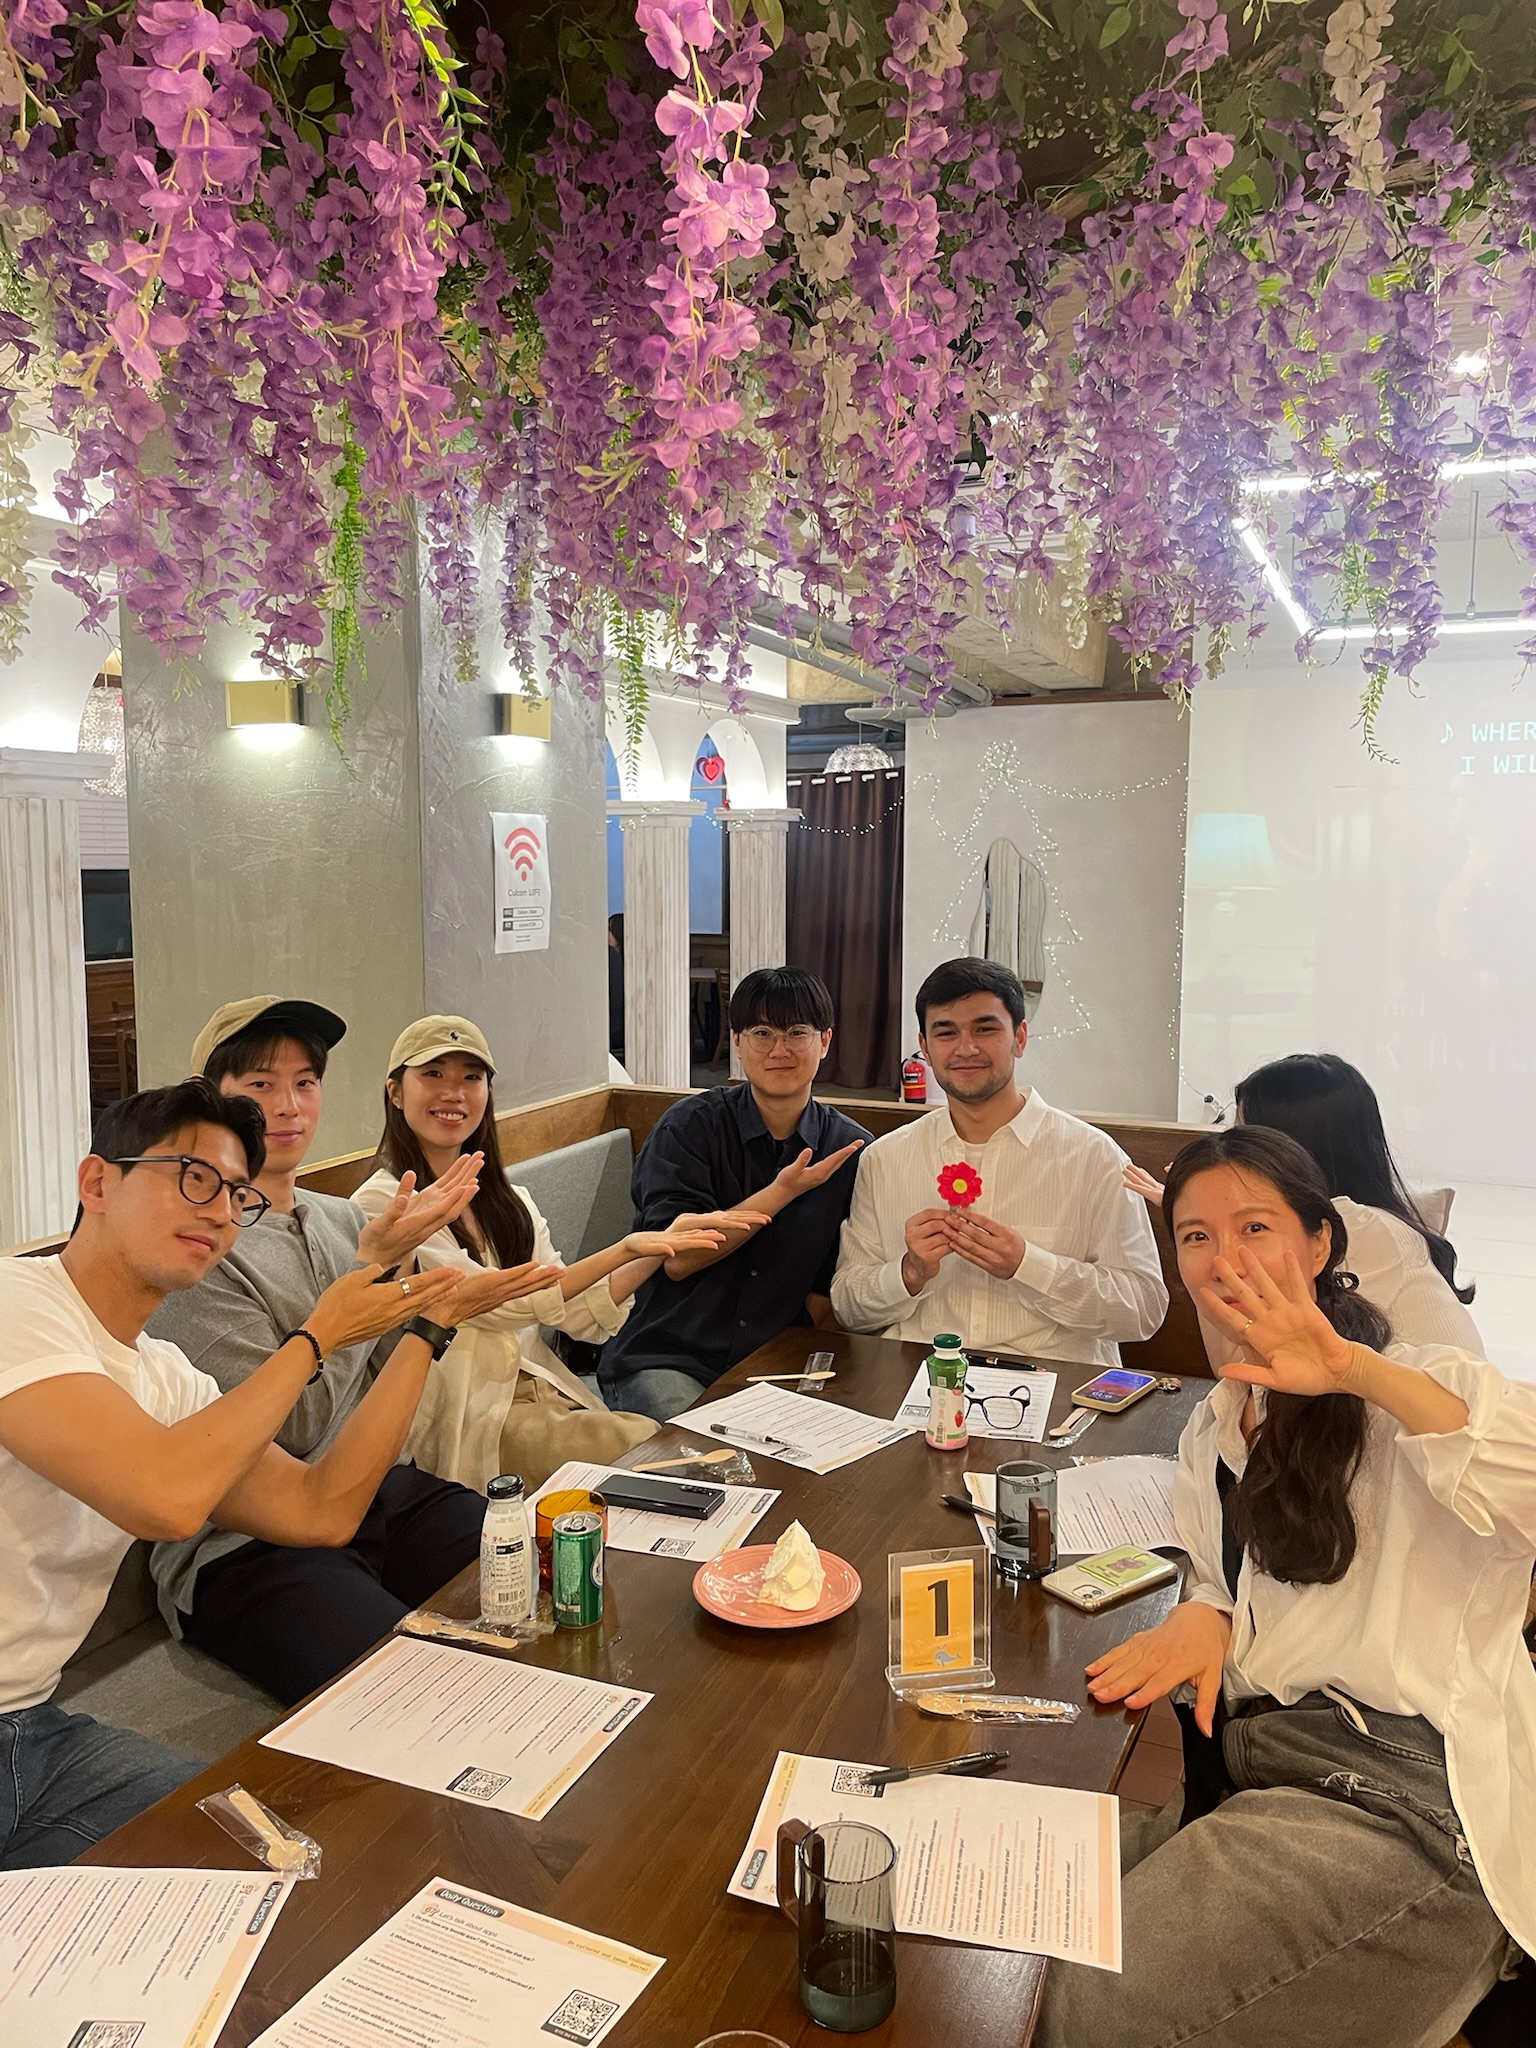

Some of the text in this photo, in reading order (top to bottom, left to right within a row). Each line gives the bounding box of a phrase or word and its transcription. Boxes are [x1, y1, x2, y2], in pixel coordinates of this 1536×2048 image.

[1461, 755, 1475, 775] I
[927, 1579, 948, 1637] 1
[606, 1700, 638, 1730] Daily Question
[742, 1852, 764, 1888] Daily Question
[250, 1884, 282, 1932] Daily Question
[440, 1890, 498, 1916] Daily Question
